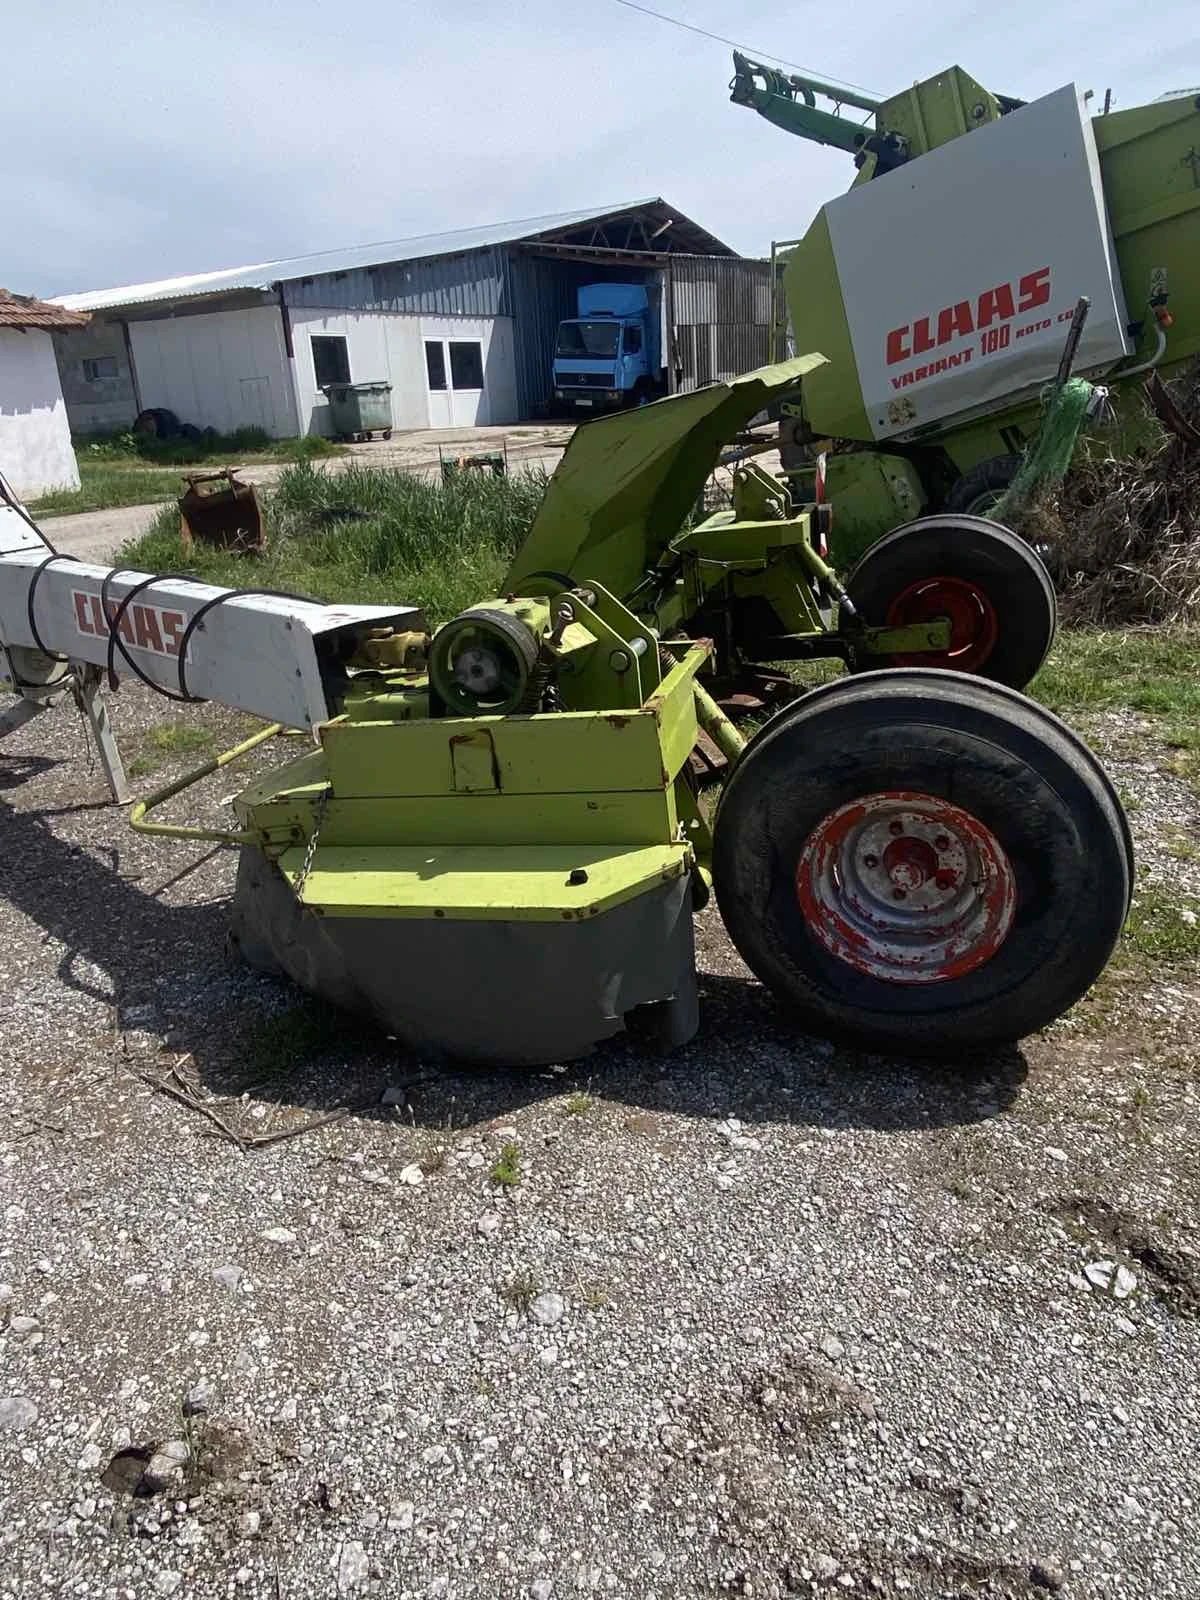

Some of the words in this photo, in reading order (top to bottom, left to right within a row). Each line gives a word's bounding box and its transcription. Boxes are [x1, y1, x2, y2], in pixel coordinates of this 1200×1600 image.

[887, 267, 1050, 365] CLAAS
[890, 348, 973, 390] VARIANT
[980, 324, 1011, 356] 180
[1016, 318, 1051, 338] ROTO
